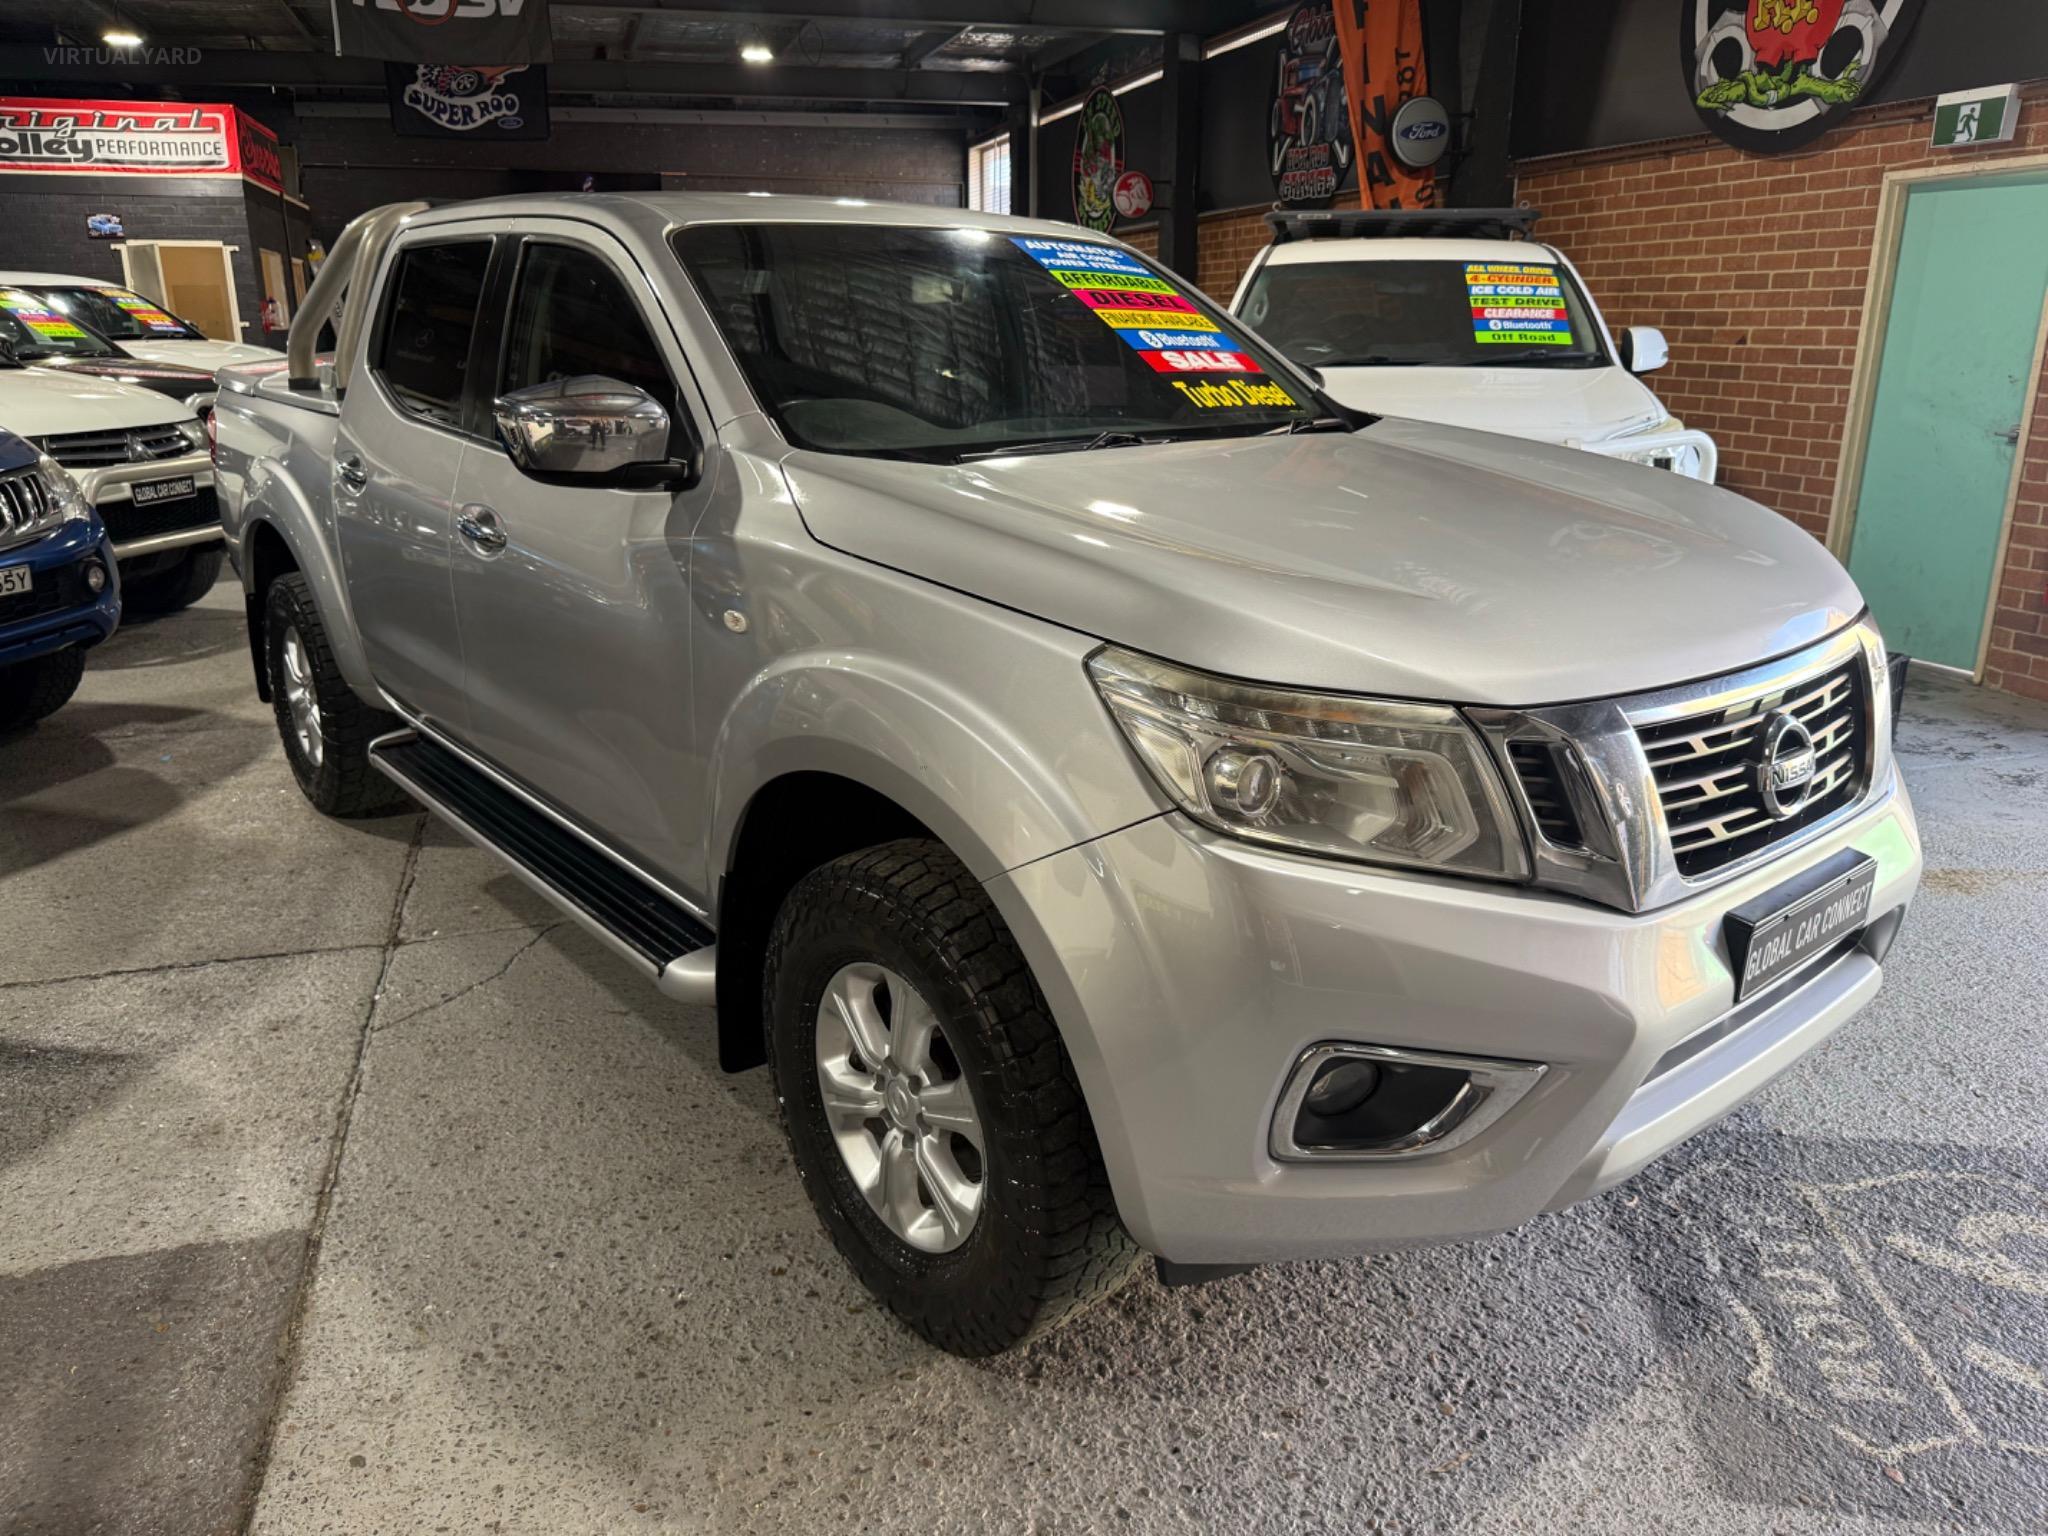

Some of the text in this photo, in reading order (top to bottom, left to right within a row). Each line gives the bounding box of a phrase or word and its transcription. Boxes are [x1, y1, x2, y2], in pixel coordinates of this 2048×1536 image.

[408, 90, 518, 126] SUPER ROO
[1409, 122, 1440, 139] Ford
[97, 138, 222, 156] PERFORMANCE
[1040, 257, 1089, 268] POWER
[1060, 270, 1168, 291] AFFORDABLE
[1471, 285, 1560, 296] ICE COLD AIR
[1090, 292, 1185, 310] DIESEL
[1472, 297, 1561, 307] TEST DRIVE
[1484, 308, 1554, 319] CLEARANCE
[1503, 320, 1552, 329] Bluetooth
[1155, 332, 1220, 347] Bluetooth
[1491, 333, 1556, 341] Off Road
[1161, 350, 1246, 370] SALE
[1172, 379, 1296, 408] Turbo Diesel
[135, 479, 193, 501] GLOBAL CAR CONNECT
[1746, 881, 1873, 981] GLOBAL CAR CONNECT
